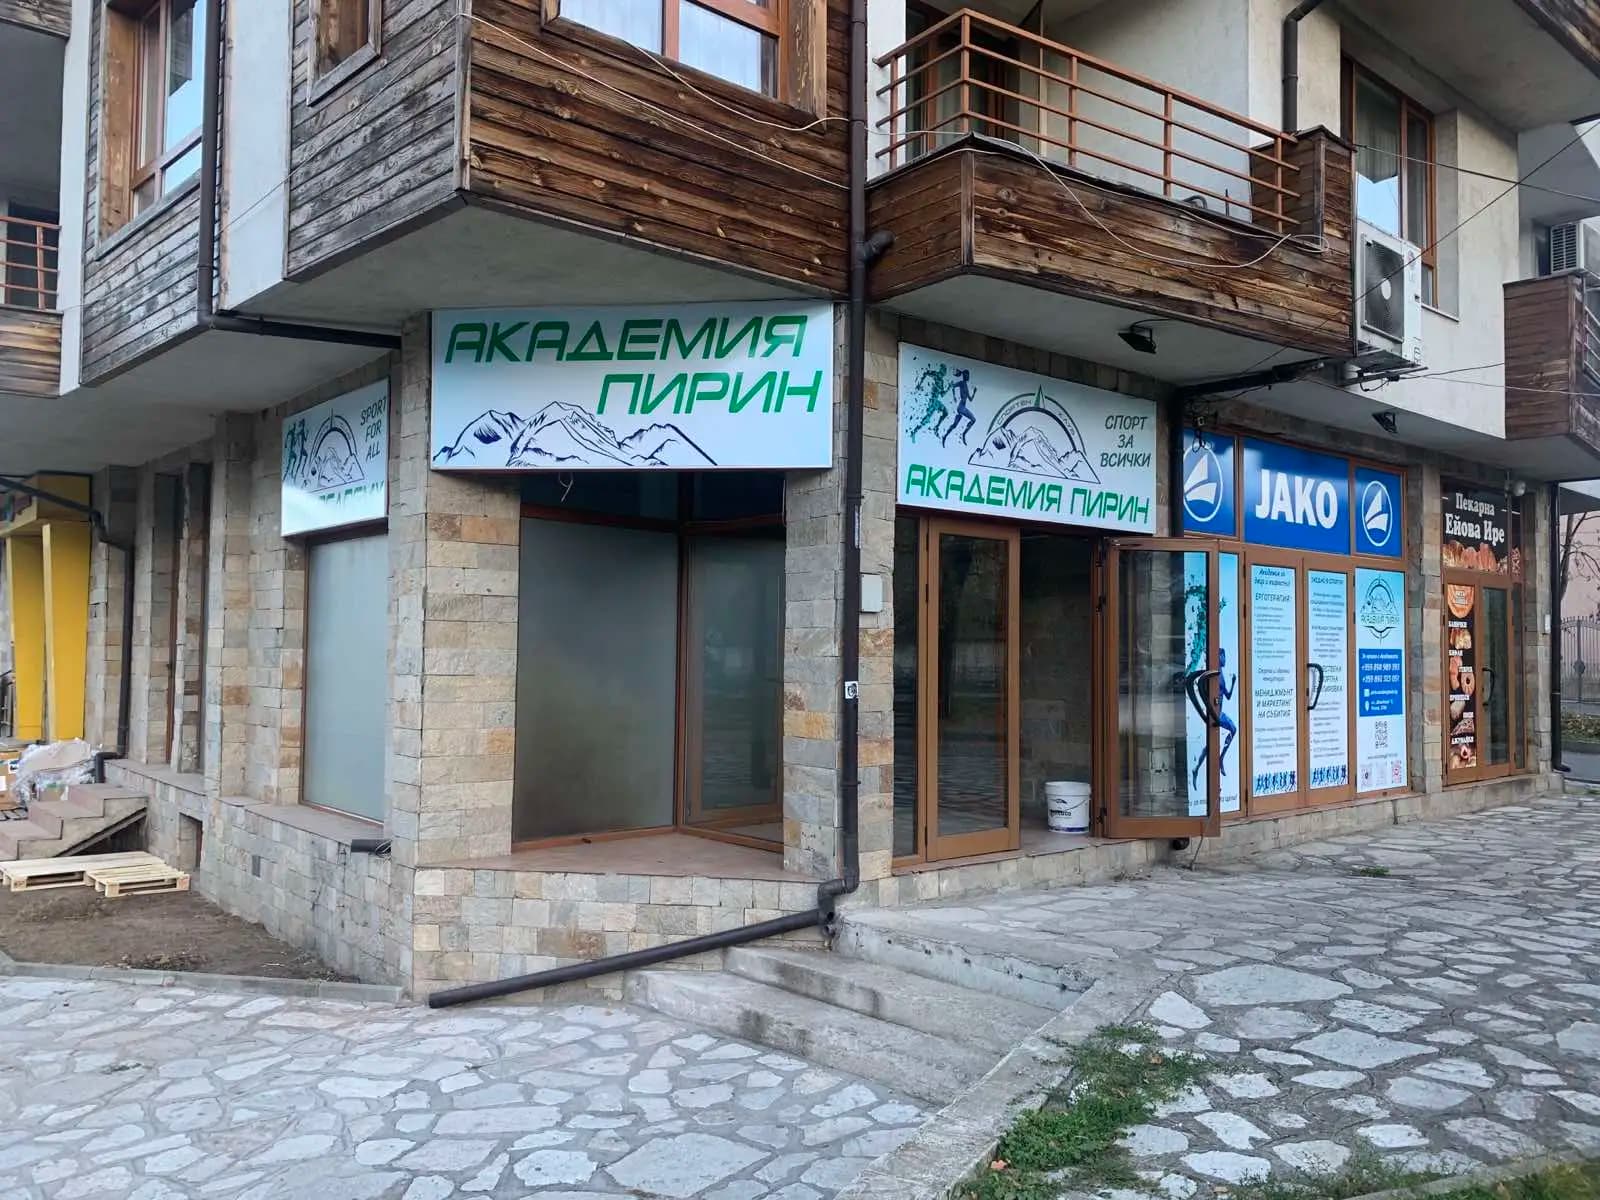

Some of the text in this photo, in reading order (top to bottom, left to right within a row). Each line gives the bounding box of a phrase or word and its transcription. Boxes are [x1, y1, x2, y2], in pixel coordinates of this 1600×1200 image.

[444, 315, 808, 364] АКАДЕМИЯ
[597, 370, 822, 415] ПИРИН
[360, 396, 387, 426] SPORT
[1105, 415, 1149, 431] СПОРТ
[365, 419, 382, 442] FOR
[1117, 437, 1134, 448] ЗА
[365, 442, 381, 463] ALL
[1100, 451, 1152, 468] ВСИЧКИ
[905, 463, 1150, 524] АКАДЕМИЯ ПИРИН
[1254, 468, 1338, 530] JAKO
[1455, 492, 1495, 518] Пекарна
[1445, 512, 1505, 546] Ейова Ире
